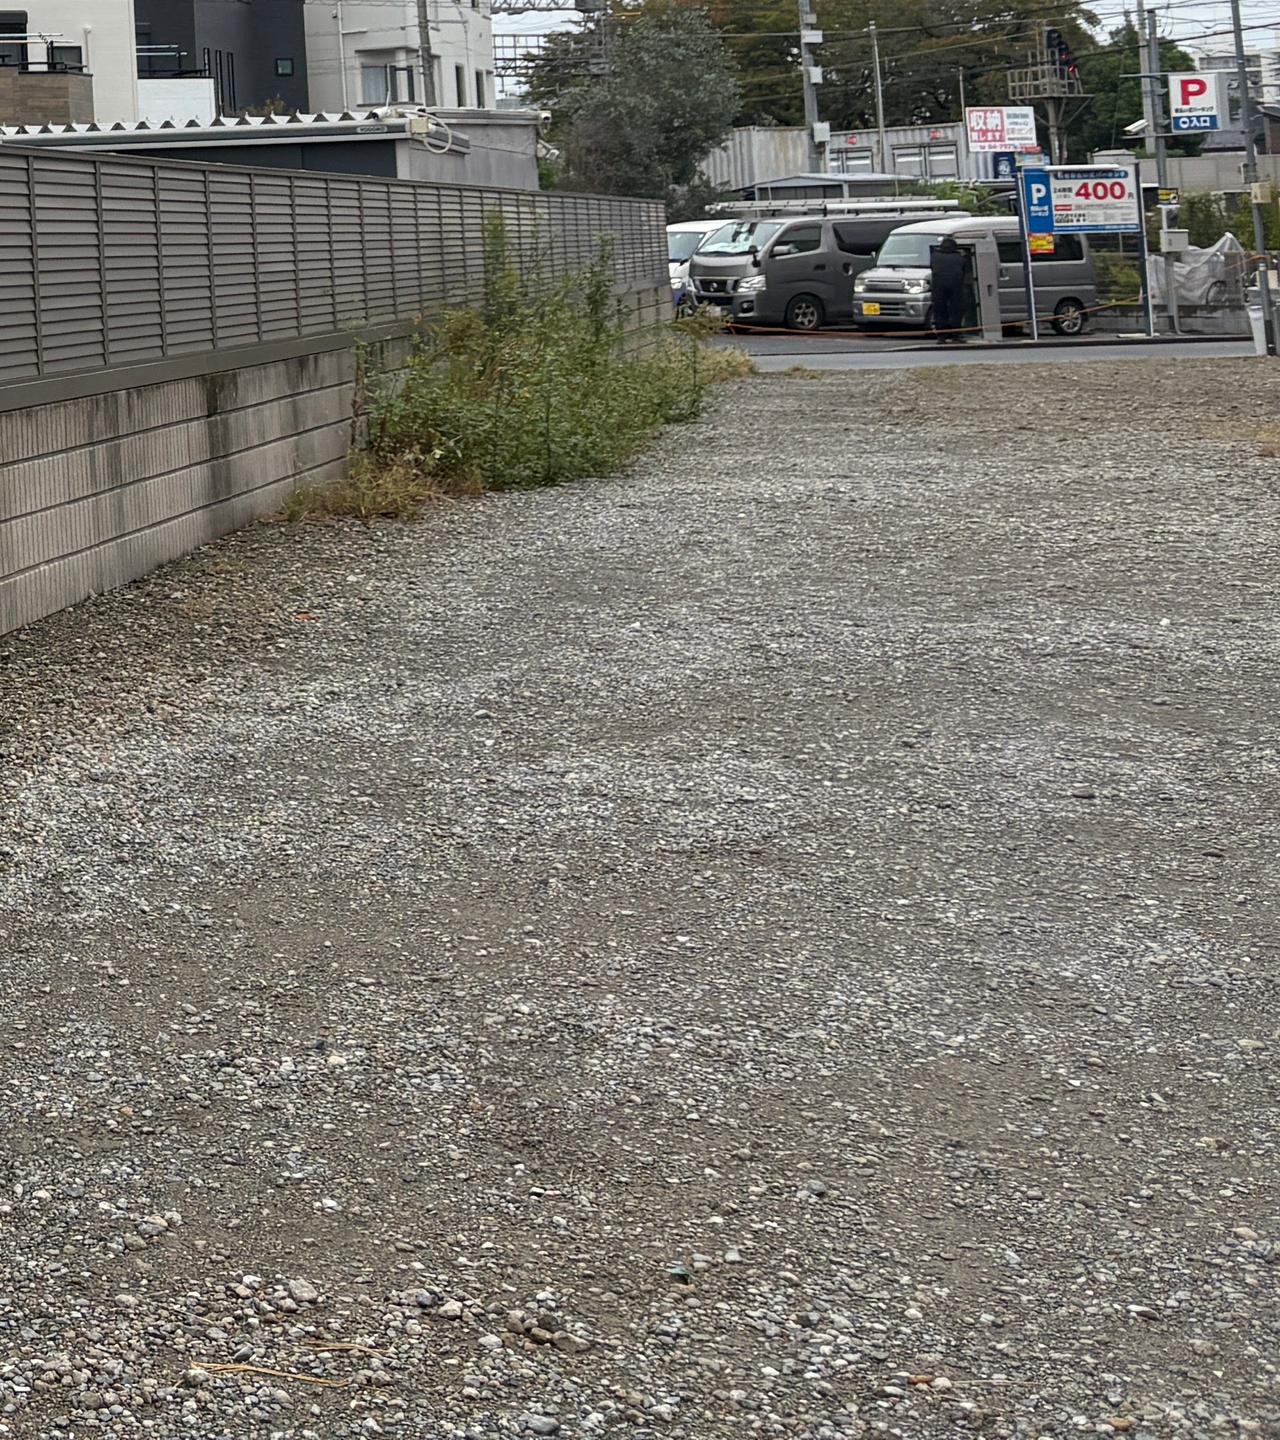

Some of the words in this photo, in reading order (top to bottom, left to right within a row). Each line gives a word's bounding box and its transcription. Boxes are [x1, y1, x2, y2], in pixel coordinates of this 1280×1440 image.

[1179, 78, 1208, 106] P
[970, 110, 1002, 131] 収納
[1189, 116, 1210, 128] 入口
[1030, 183, 1047, 205] P
